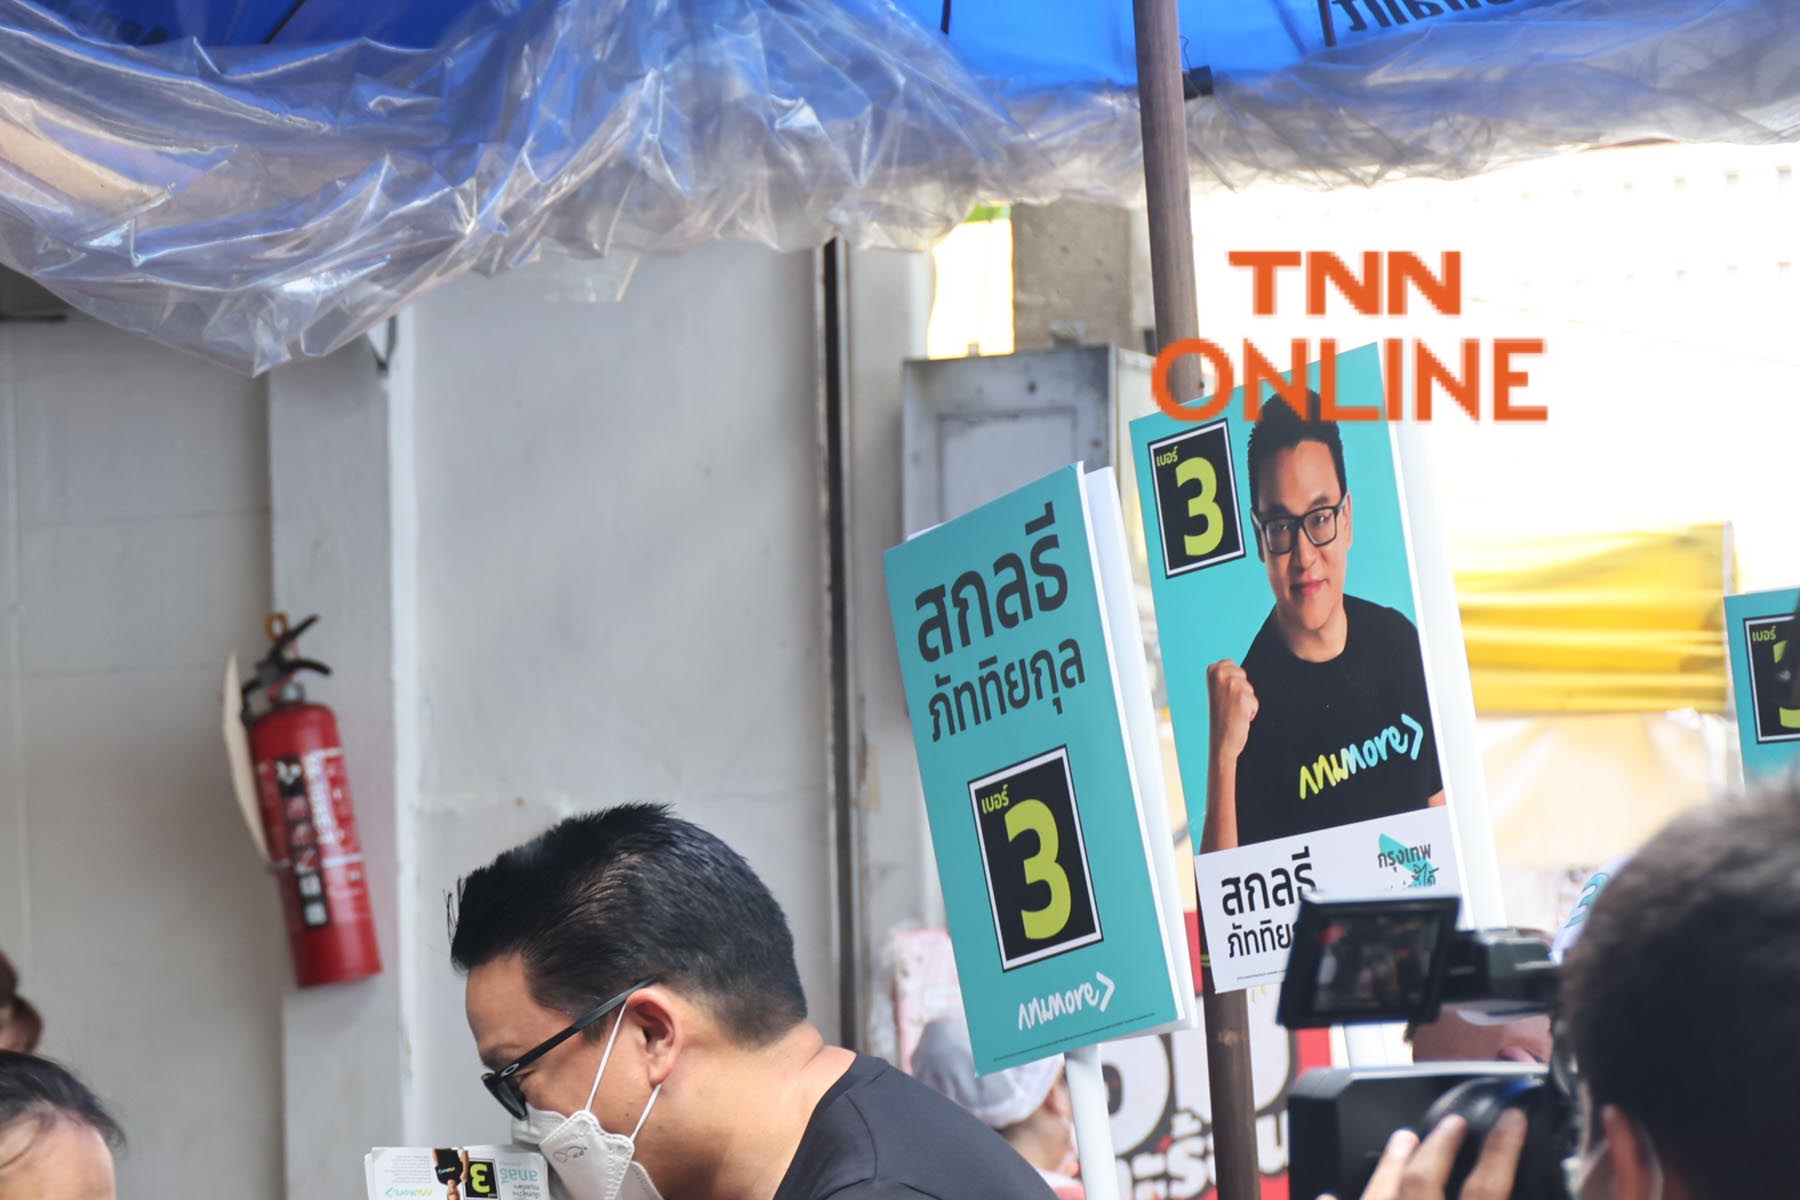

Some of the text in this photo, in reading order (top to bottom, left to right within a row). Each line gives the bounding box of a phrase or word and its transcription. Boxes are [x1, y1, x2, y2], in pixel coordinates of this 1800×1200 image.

[1156, 445, 1179, 467] เบอร์
[1175, 456, 1224, 557] 3
[914, 501, 1068, 663] สกลธี
[1752, 625, 1777, 642] เบอร์
[928, 638, 1086, 742] ภัททิยกุล
[981, 784, 1010, 815] เบอร์
[1004, 799, 1072, 940] 3
[1377, 843, 1432, 873] กรุงเทพ
[470, 1163, 490, 1194] 3
